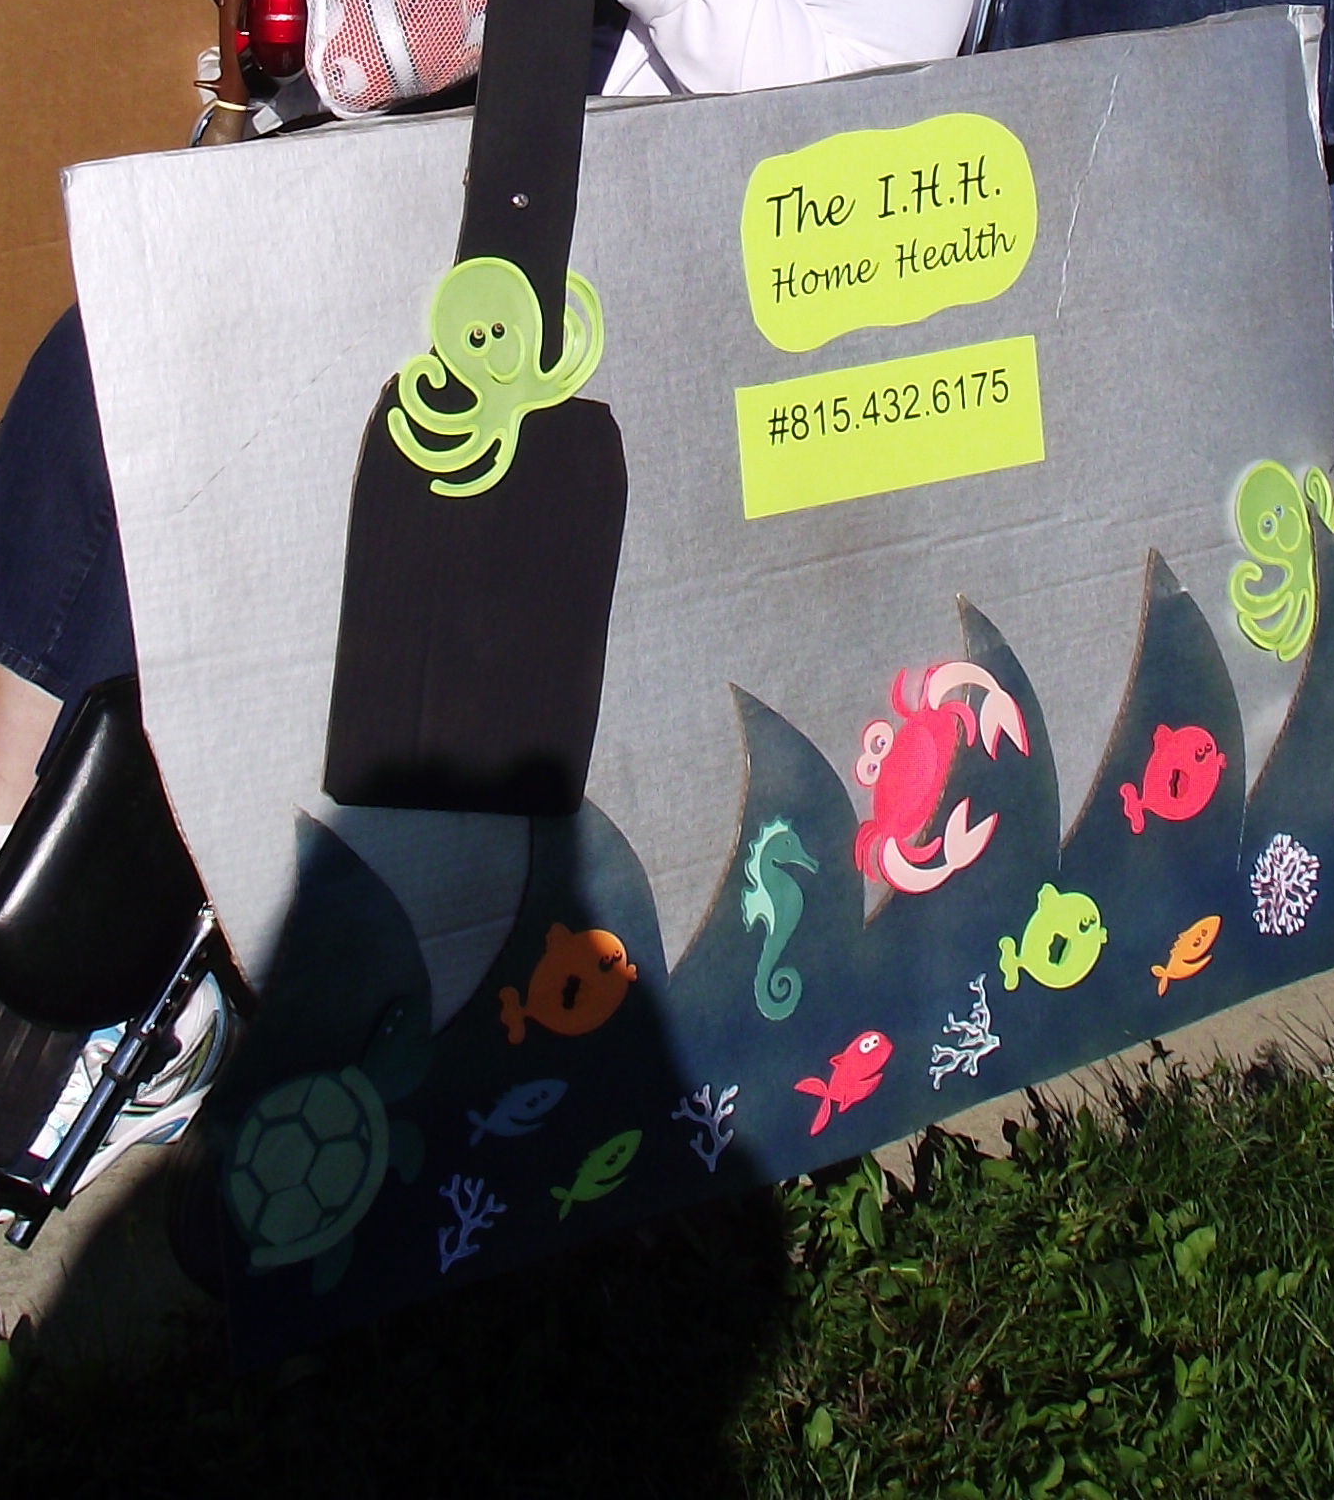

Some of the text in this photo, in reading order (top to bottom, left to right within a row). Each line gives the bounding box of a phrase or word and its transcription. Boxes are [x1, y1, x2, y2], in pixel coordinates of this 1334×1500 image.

[766, 155, 1002, 238] The I.H.H.
[771, 223, 1017, 303] Home Health
[768, 368, 1009, 446] #815.432.6175
